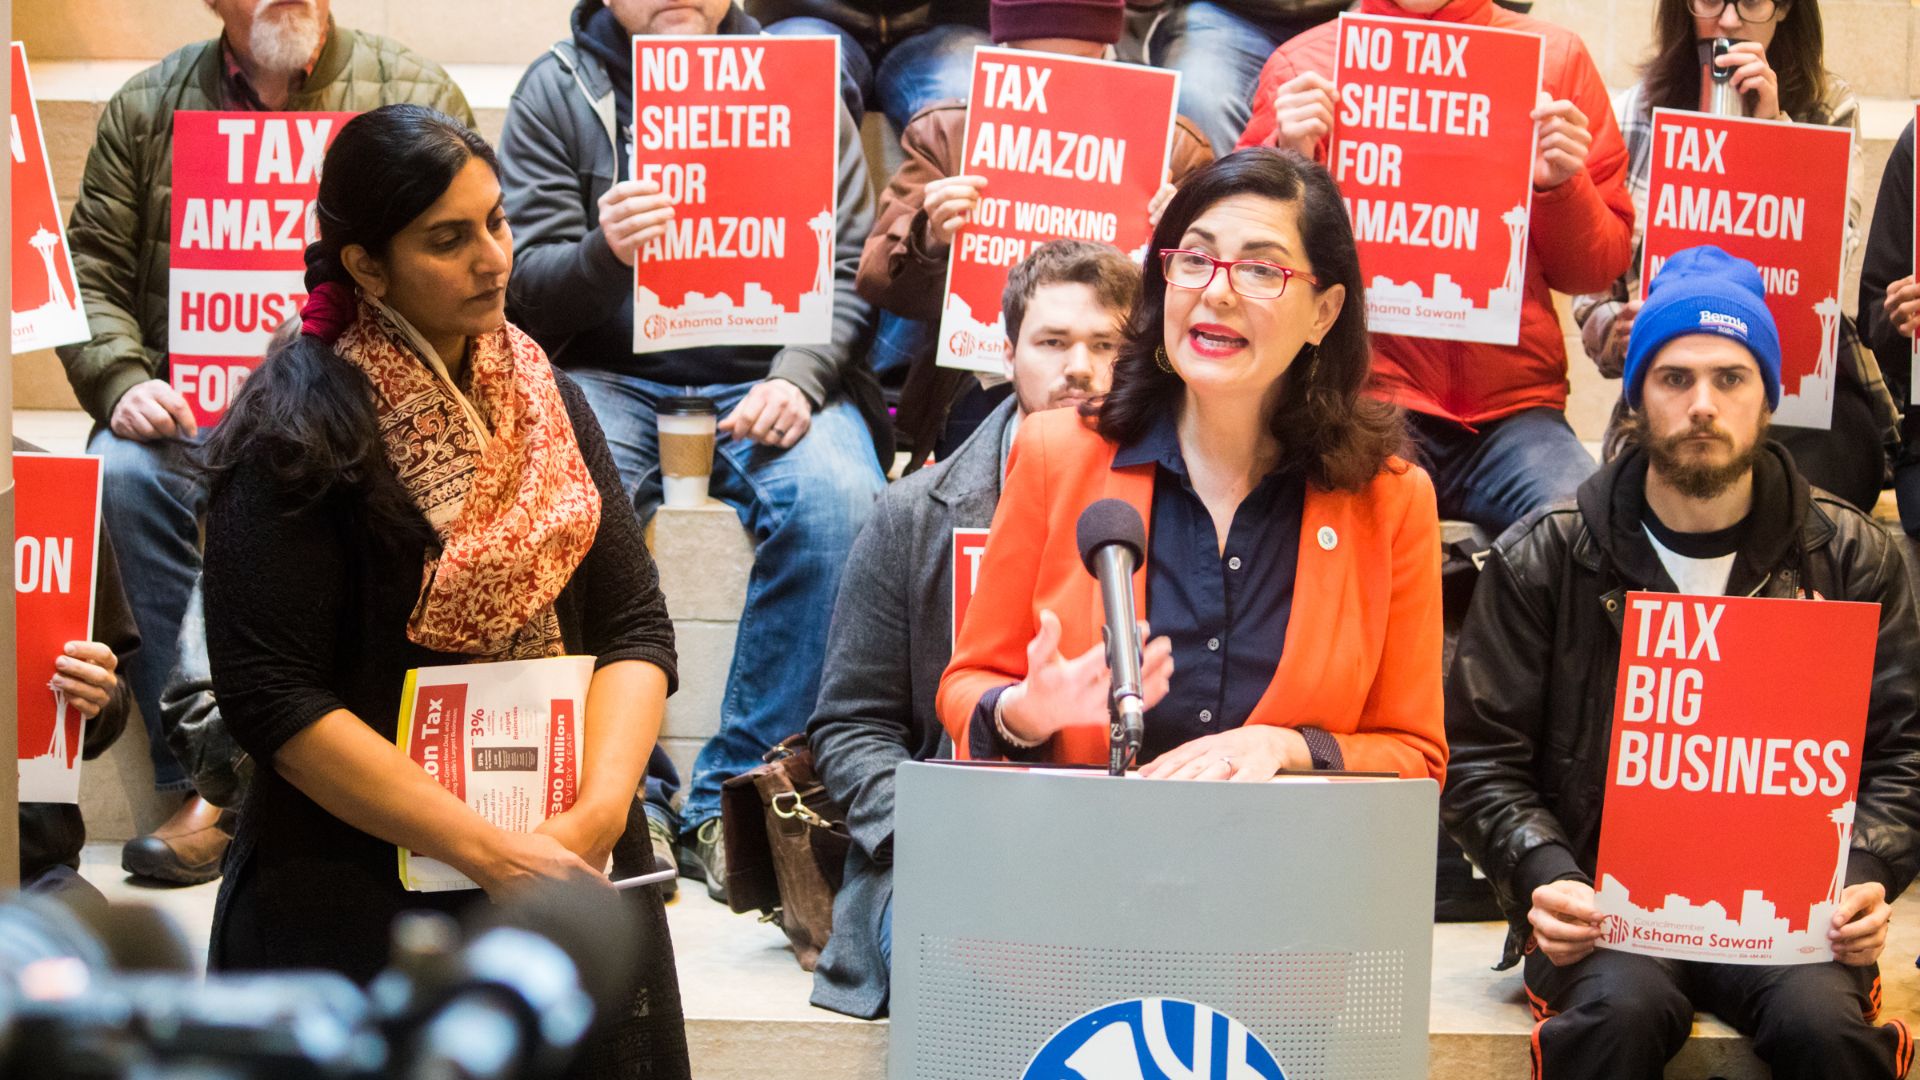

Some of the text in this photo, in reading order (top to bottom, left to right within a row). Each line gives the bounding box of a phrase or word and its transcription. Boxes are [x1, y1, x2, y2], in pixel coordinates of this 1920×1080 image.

[641, 47, 766, 92] NO TAX
[1344, 25, 1469, 78] NO TAX
[981, 62, 1051, 114] TAX
[1340, 83, 1490, 137] SHELTER
[641, 104, 791, 150] SHELTER
[1661, 124, 1728, 175] TAX
[218, 119, 333, 184] TAX
[970, 122, 1126, 184] AMAZON
[1336, 139, 1403, 187] FOR
[965, 197, 1117, 242] NOT WORKING
[1653, 183, 1805, 241] AMAZON
[1757, 265, 1799, 296] ING
[669, 314, 778, 330] Kshama Sawant
[1416, 305, 1466, 320] Sawant
[1699, 310, 1748, 332] Bernie
[1632, 600, 1726, 661] TAX
[1623, 665, 1703, 726] BIG
[421, 698, 443, 740] Tax
[470, 708, 485, 737] 3%
[504, 711, 512, 736] Largest
[442, 748, 450, 761] New
[450, 738, 459, 758] Largest
[553, 714, 566, 774] Million
[1615, 730, 1850, 797] BUSINESS
[565, 732, 573, 804] EVERY YEAR
[1632, 926, 1773, 950] Kshama Sawant
[1633, 917, 1705, 931] Councilmember
